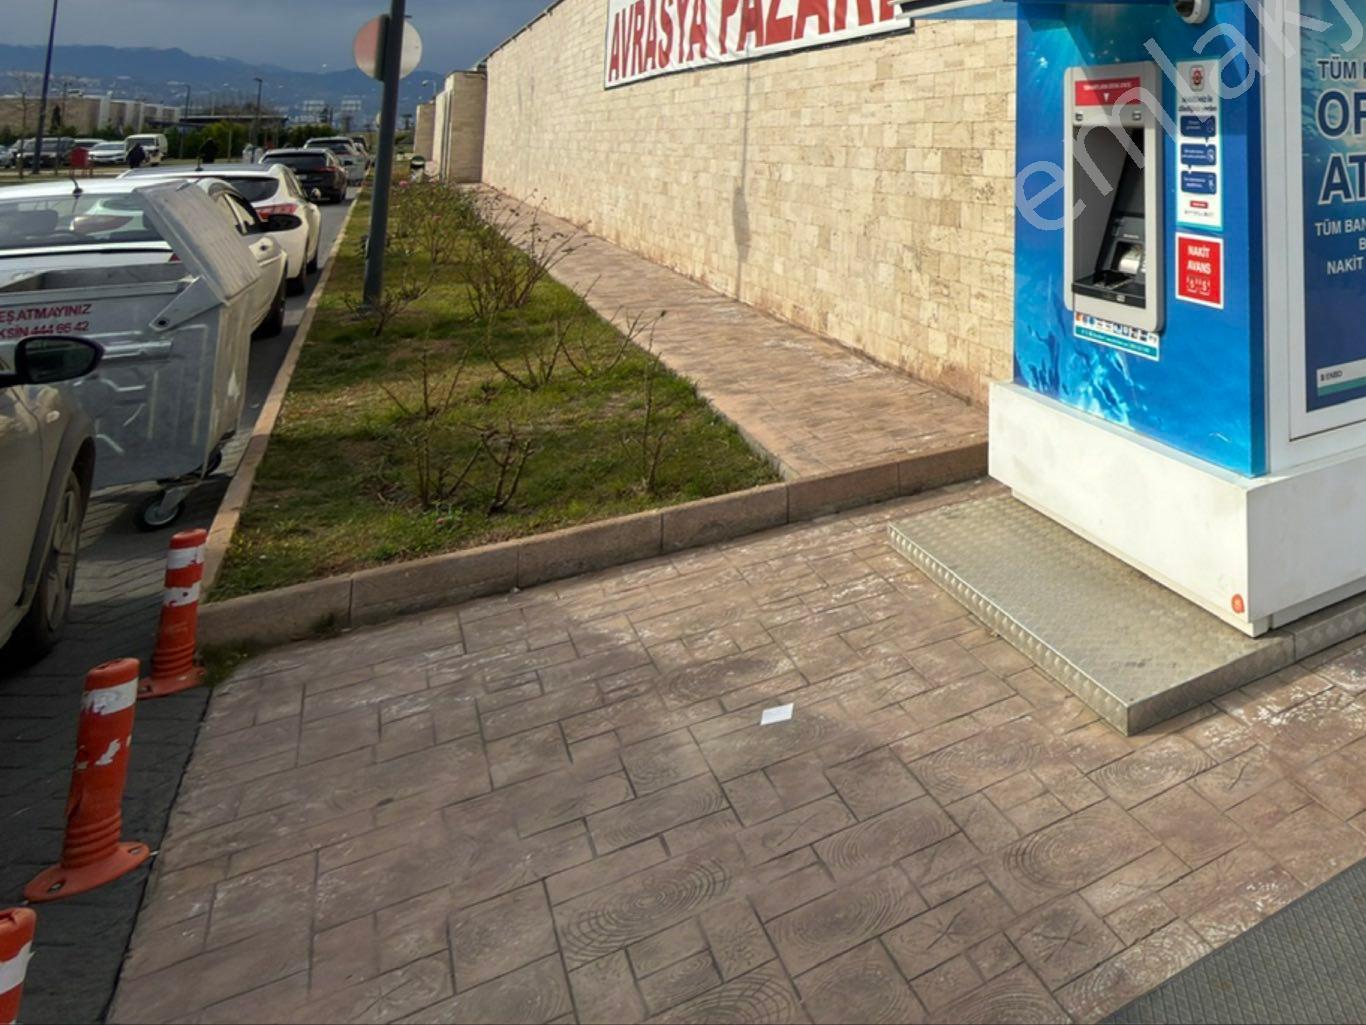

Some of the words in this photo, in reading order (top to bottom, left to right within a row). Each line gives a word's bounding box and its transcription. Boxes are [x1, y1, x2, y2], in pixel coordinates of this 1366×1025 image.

[1317, 55, 1357, 80] TÜM
[1315, 219, 1342, 237] TÜM
[1187, 244, 1211, 258] NAKİT
[1187, 260, 1212, 275] AVANS
[1327, 255, 1365, 275] NAKİT
